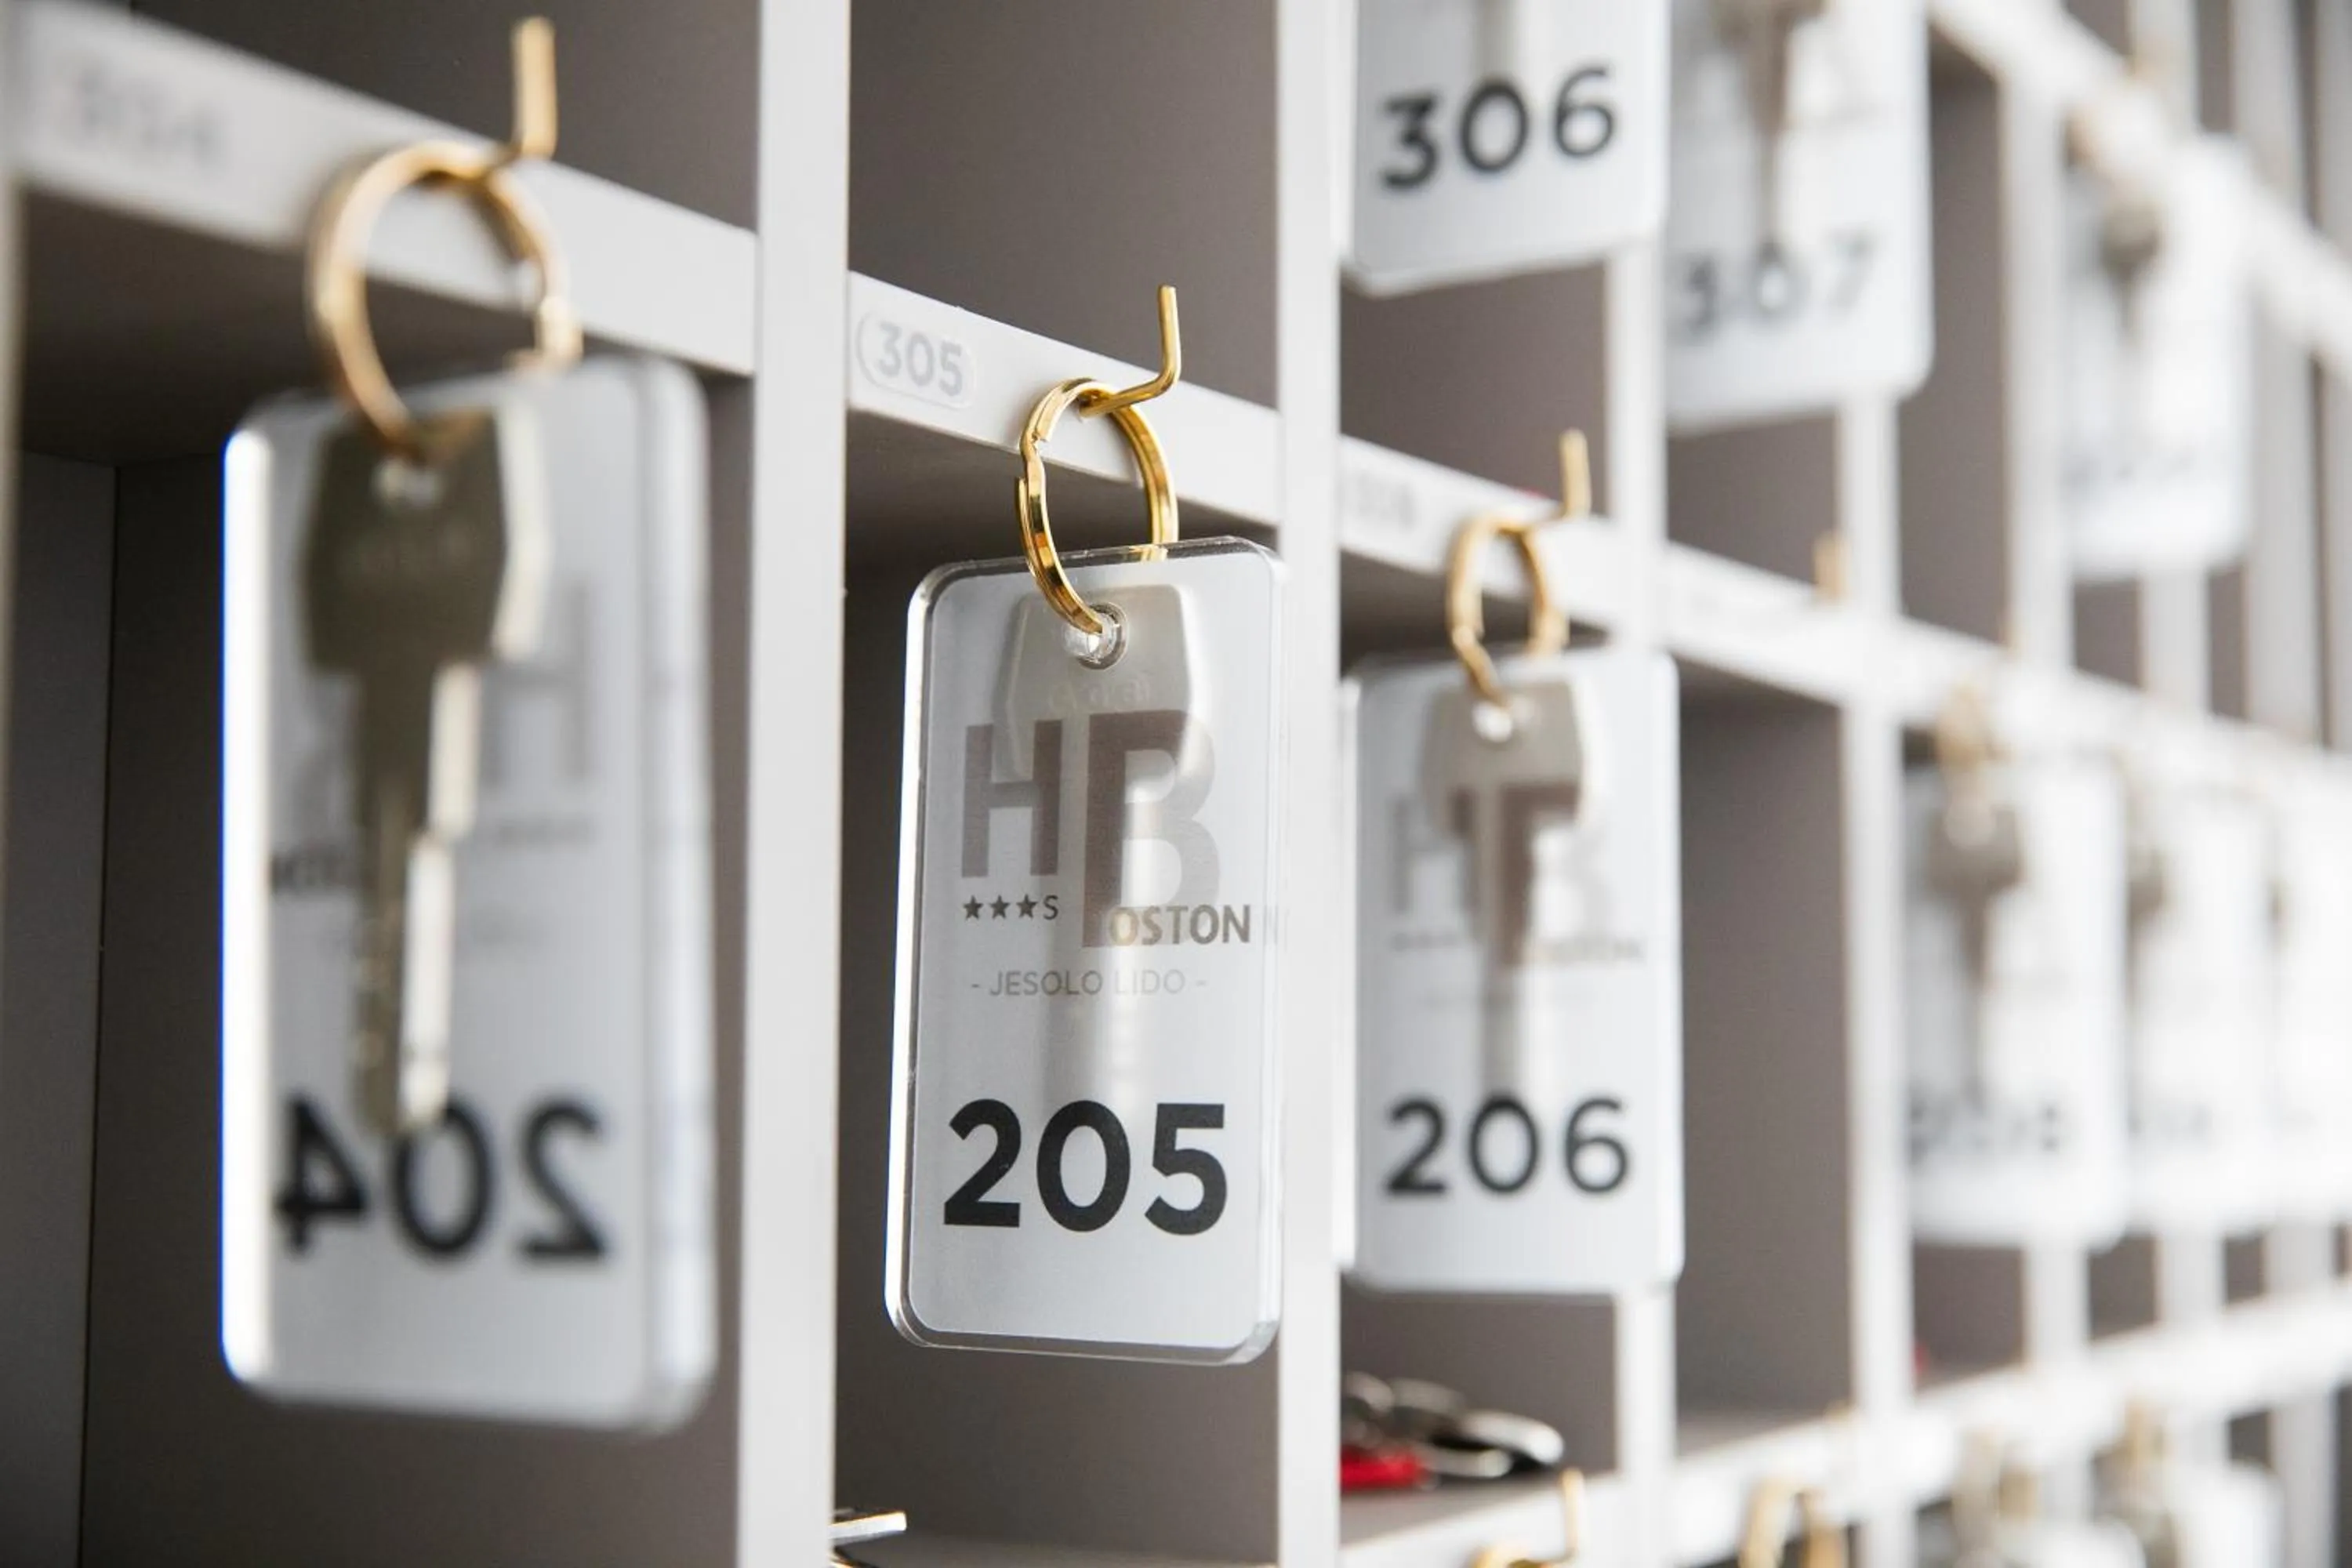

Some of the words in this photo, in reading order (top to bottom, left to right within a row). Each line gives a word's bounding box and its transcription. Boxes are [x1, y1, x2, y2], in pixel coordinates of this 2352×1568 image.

[1380, 64, 1615, 192] 306
[874, 321, 964, 397] 305
[989, 969, 1103, 996] JESOLO
[1114, 968, 1186, 996] LIDO
[943, 1098, 1228, 1236] 205
[1386, 1096, 1629, 1196] 206
